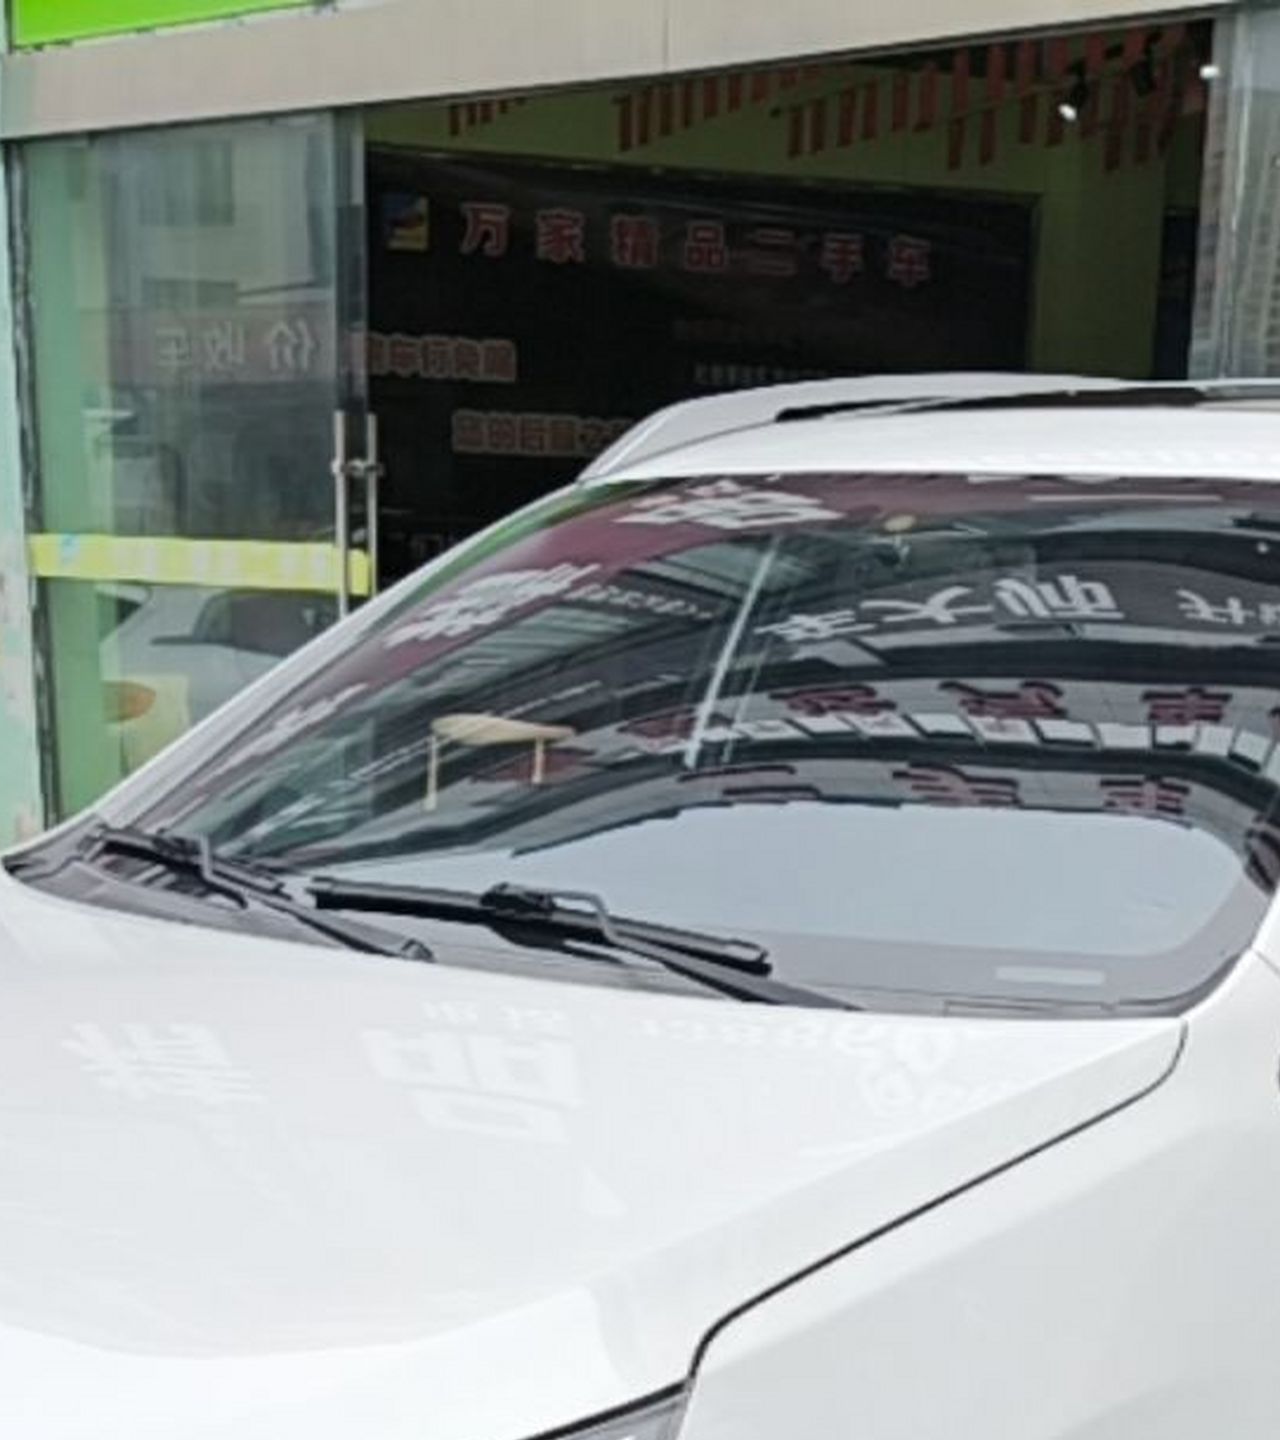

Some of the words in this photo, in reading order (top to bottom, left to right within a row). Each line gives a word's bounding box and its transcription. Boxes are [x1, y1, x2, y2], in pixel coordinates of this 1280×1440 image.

[460, 202, 933, 287] 万家精品二手车
